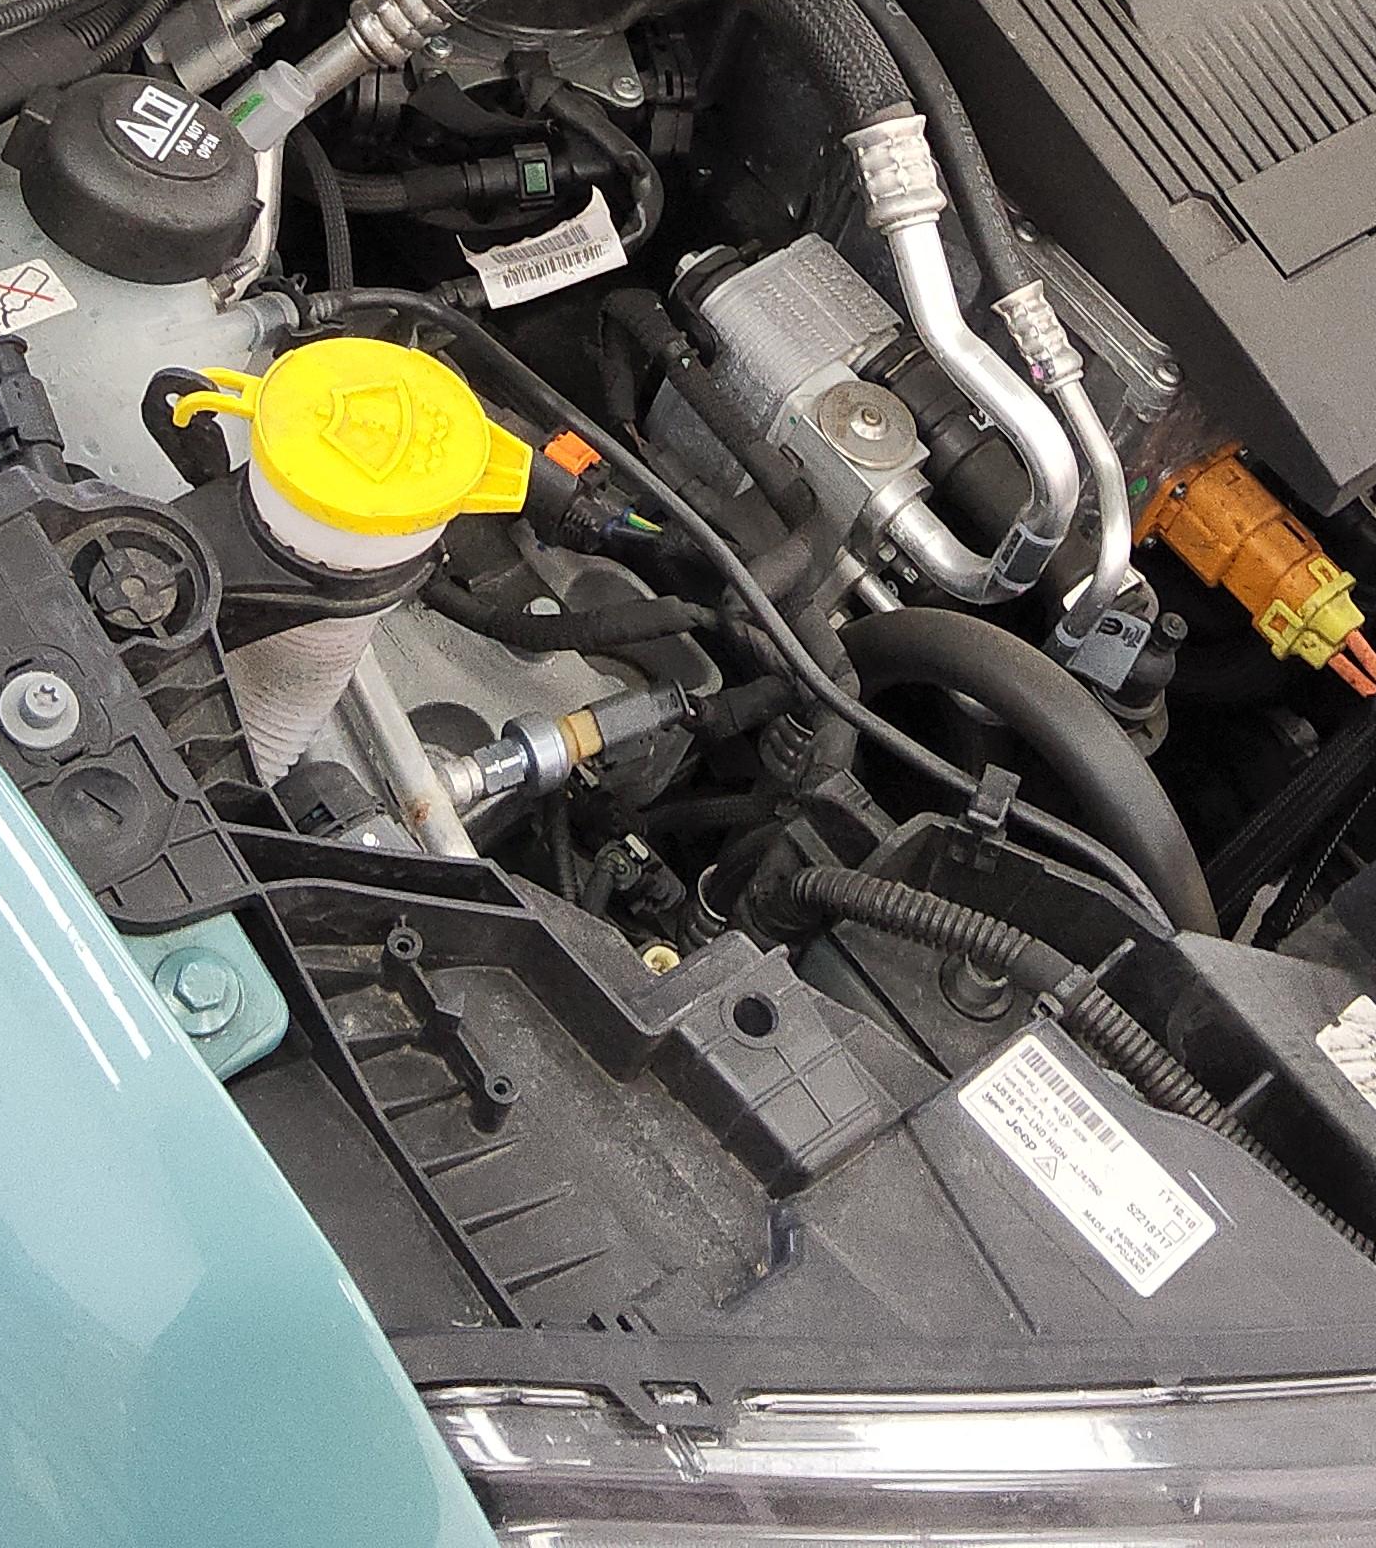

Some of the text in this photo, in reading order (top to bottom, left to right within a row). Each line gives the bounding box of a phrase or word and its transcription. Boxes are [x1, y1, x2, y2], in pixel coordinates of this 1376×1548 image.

[175, 119, 206, 156] DO NOT
[196, 133, 222, 160] OPEN
[1003, 1114, 1041, 1152] Jeep
[1081, 1207, 1146, 1276] MADE IN POLAND
